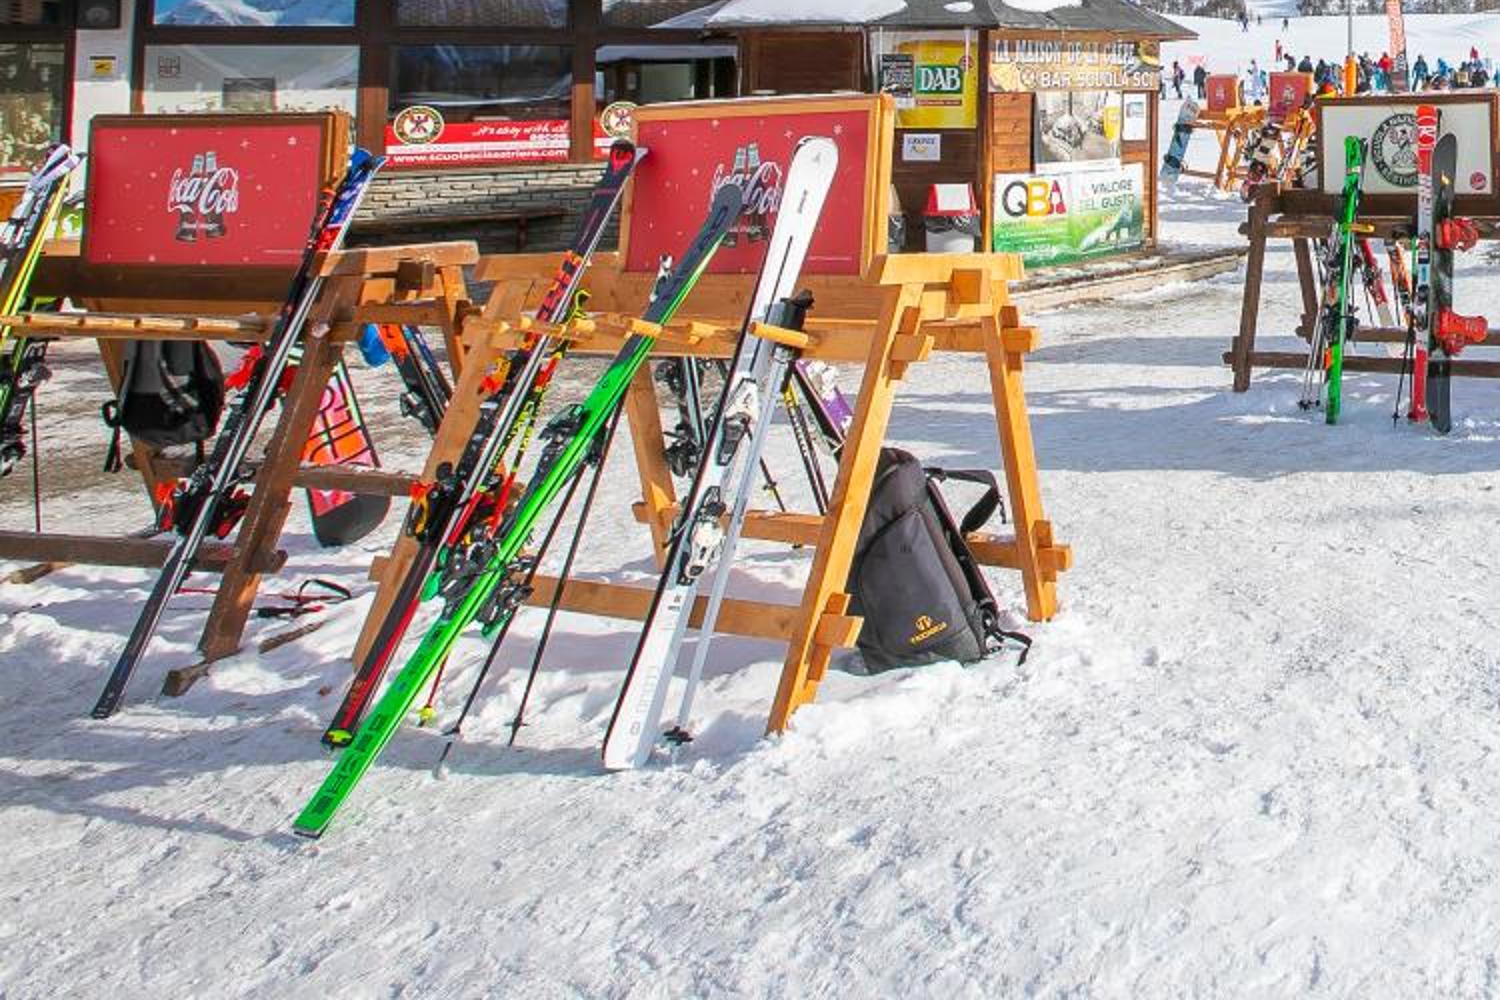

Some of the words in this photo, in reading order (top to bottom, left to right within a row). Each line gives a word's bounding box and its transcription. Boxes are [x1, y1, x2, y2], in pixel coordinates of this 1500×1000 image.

[918, 66, 961, 91] DAB
[1041, 71, 1071, 87] BAR
[1078, 71, 1129, 88] SCUOLA
[1134, 70, 1153, 87] SCI
